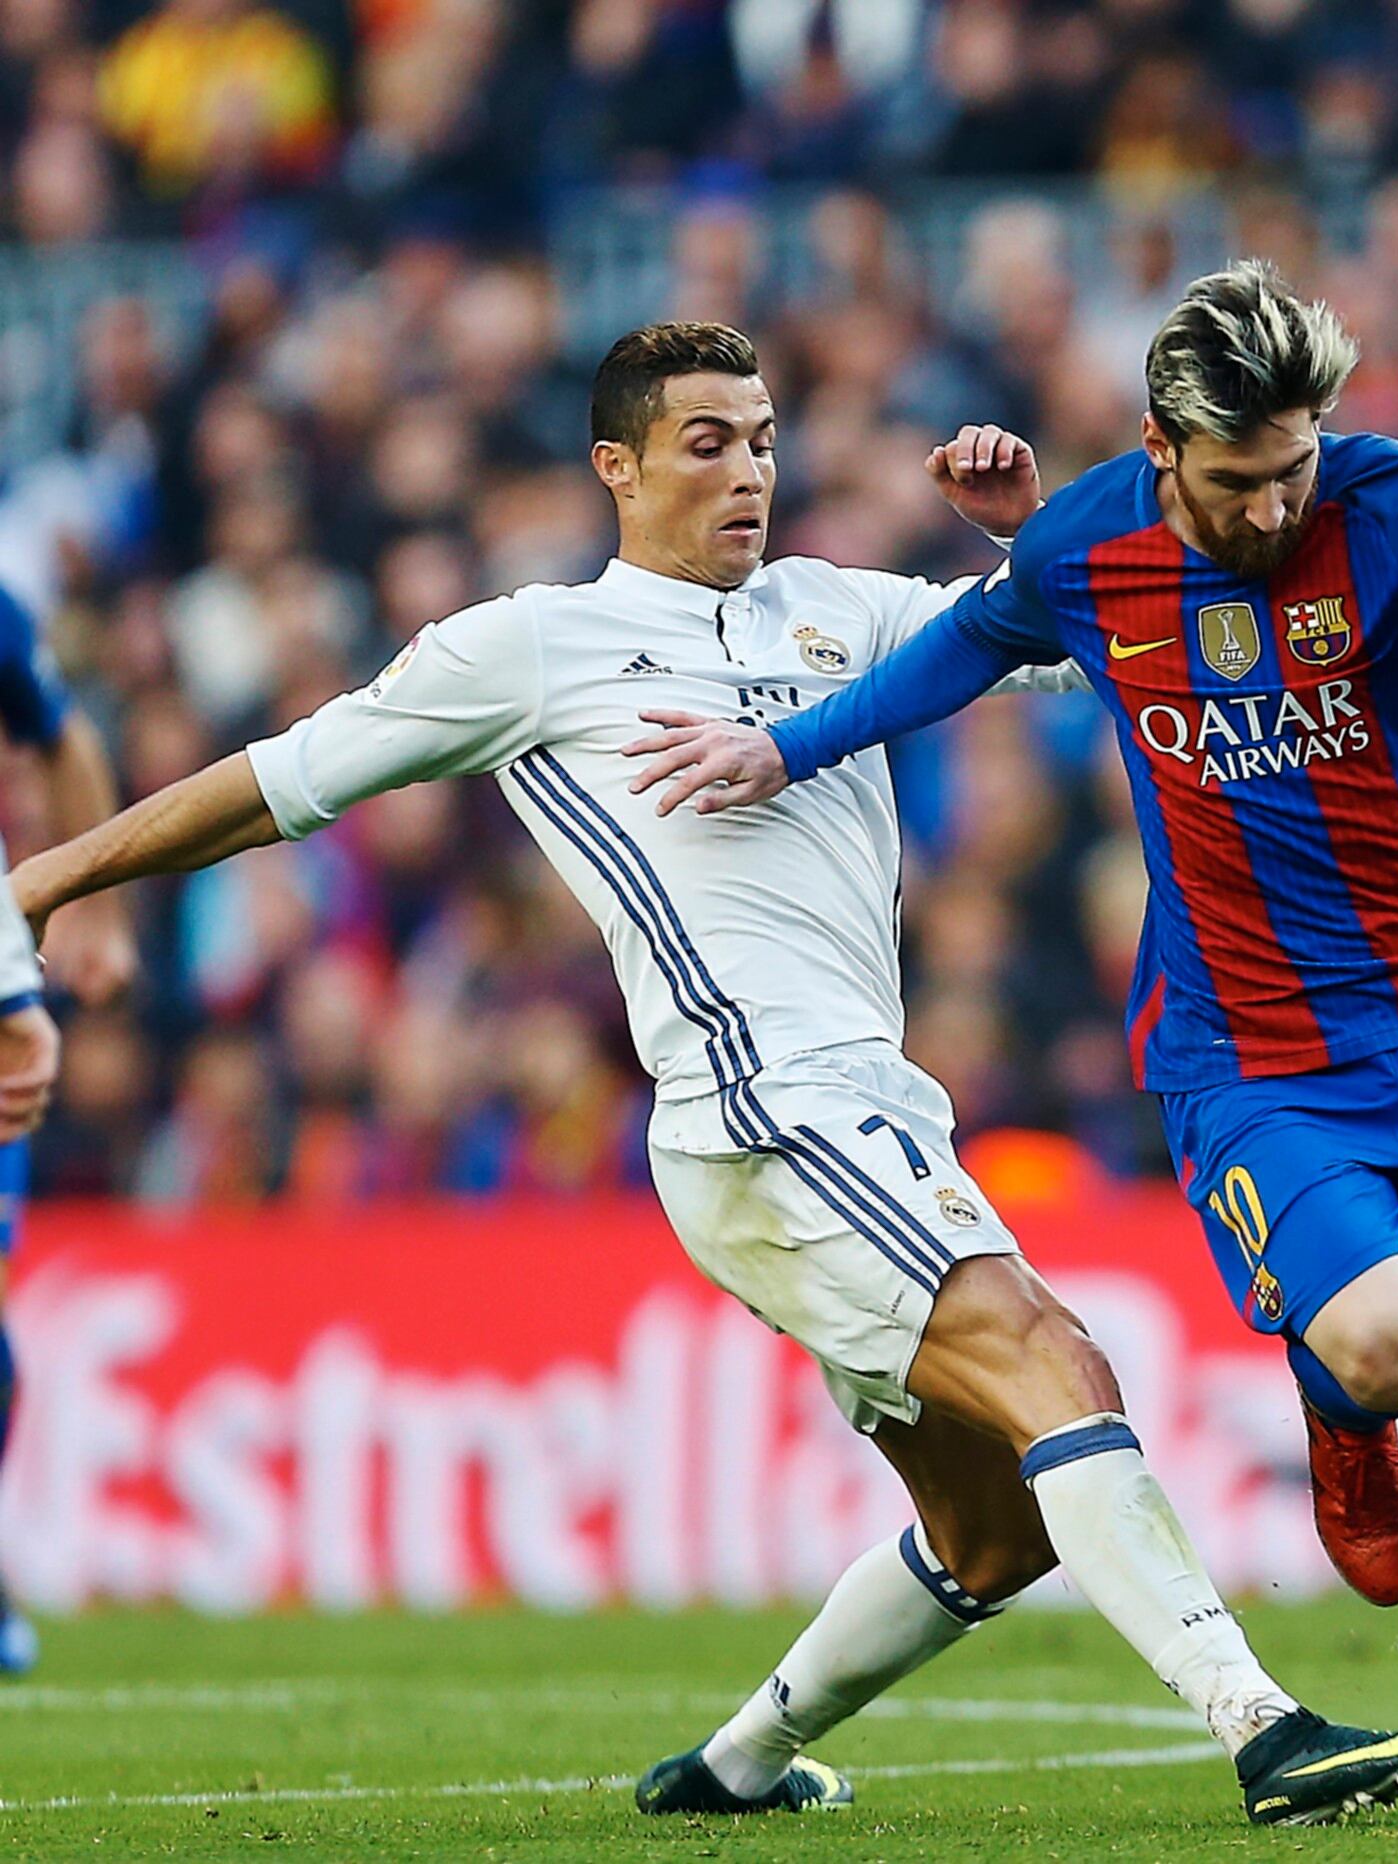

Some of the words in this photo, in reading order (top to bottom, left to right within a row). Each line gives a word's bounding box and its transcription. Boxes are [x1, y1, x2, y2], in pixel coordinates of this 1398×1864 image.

[1219, 649, 1247, 662] FIFA
[1138, 680, 1362, 763] QATAR
[1200, 720, 1370, 786] AIRWAYS
[856, 1114, 931, 1182] 7
[1208, 1165, 1268, 1274] 10
